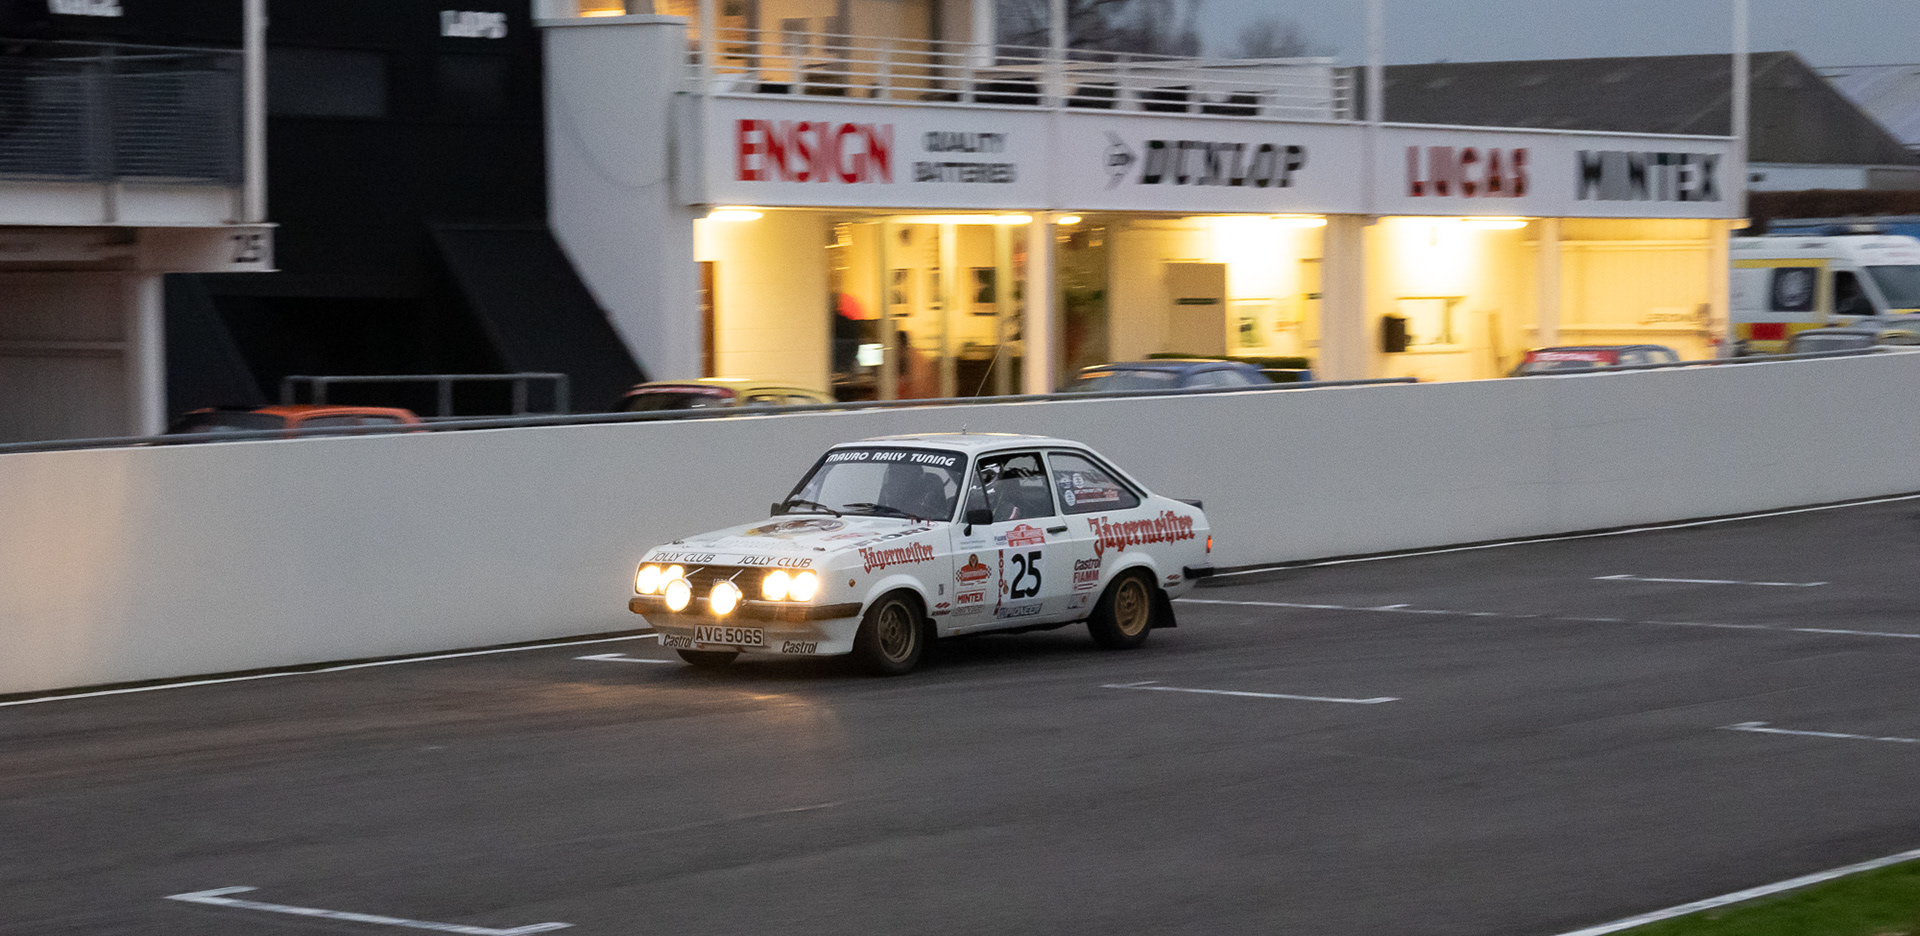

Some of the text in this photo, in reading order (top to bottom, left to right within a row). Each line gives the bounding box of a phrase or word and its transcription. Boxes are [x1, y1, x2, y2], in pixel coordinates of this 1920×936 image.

[921, 131, 1008, 153] QUALITY
[735, 119, 894, 184] ENSIGN
[911, 161, 1016, 184] BATTERIES
[1136, 140, 1307, 188] DUNLOP
[1405, 146, 1529, 198] LUCAS
[1576, 150, 1722, 202] MINTEX
[826, 452, 956, 466] MAURO RALLY TUNING
[650, 552, 716, 563] JOLLY CLUB
[737, 555, 812, 568] JOLLY CLUB
[1011, 551, 1042, 599] 25
[1073, 570, 1099, 583] FIAMM
[957, 592, 984, 604] MINTEX
[663, 634, 693, 648] Castrol
[695, 627, 762, 644] AVG 506S
[782, 641, 818, 654] Castrol
